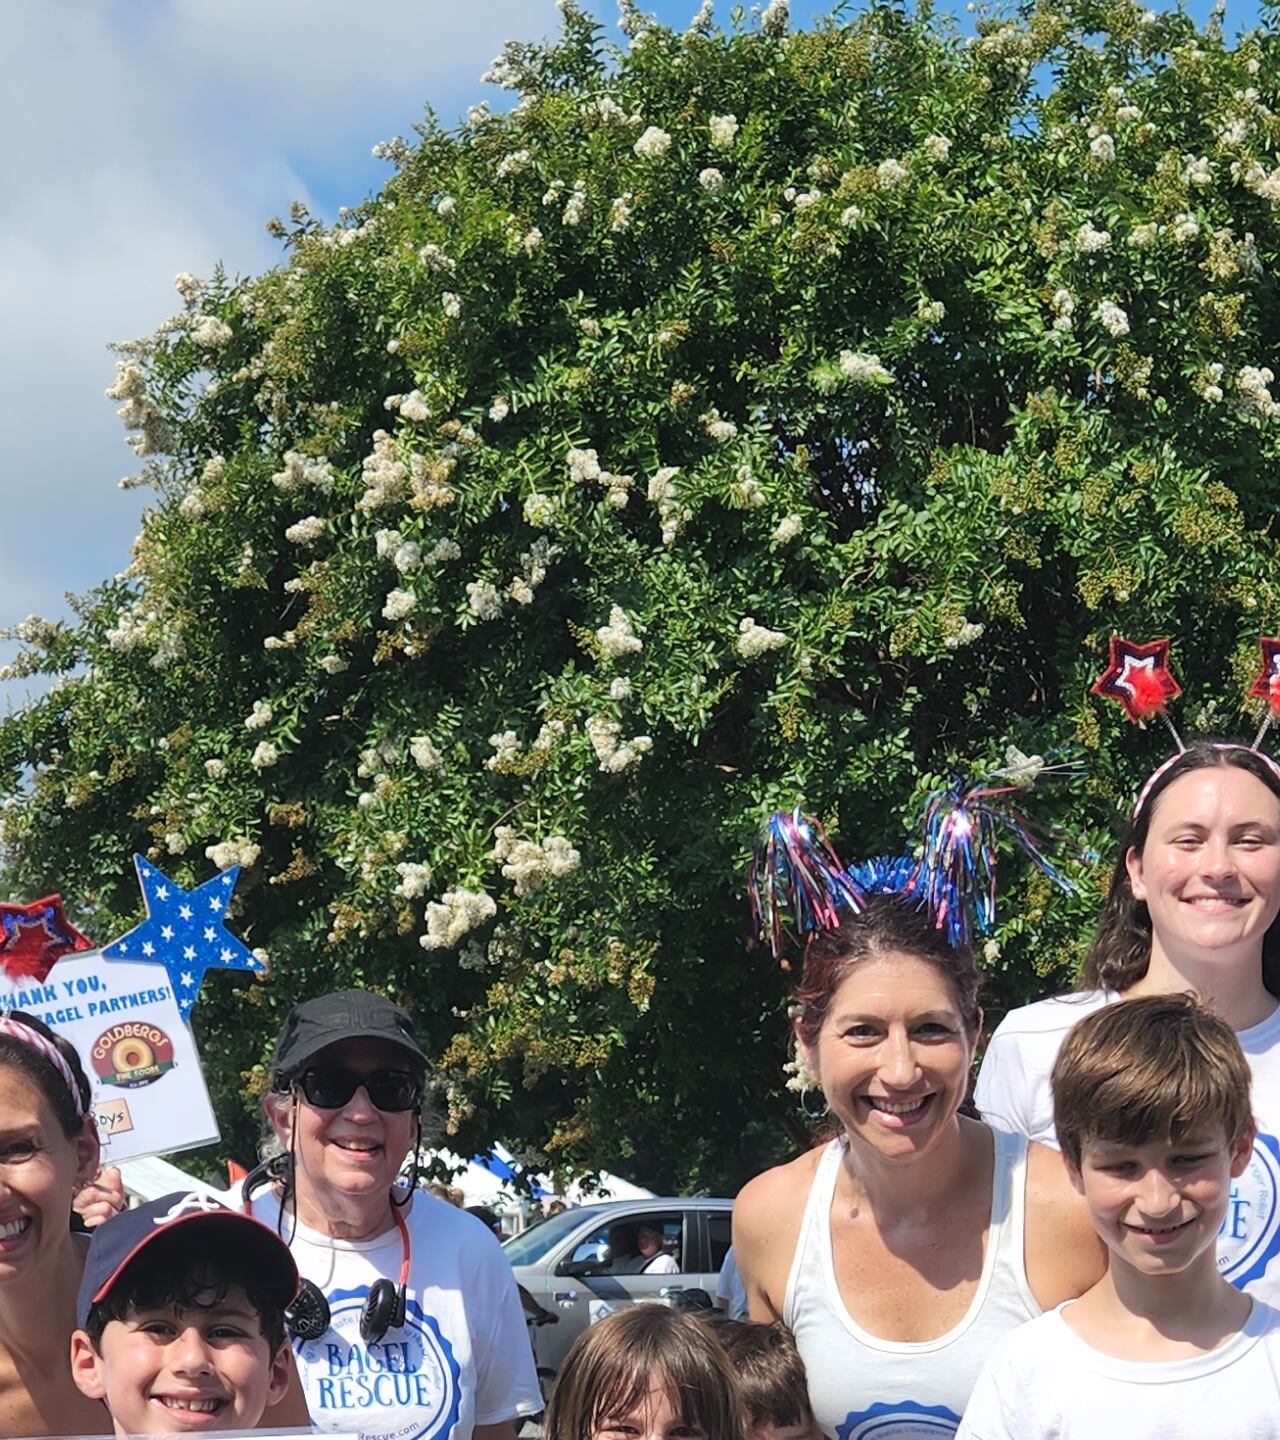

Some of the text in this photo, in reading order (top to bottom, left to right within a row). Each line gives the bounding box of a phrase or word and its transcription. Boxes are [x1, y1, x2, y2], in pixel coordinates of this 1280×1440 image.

[62, 975, 107, 998] YOU,
[88, 986, 171, 1017] PARTNERS!
[93, 1023, 169, 1060] GOLDBERGS
[325, 1342, 416, 1377] BAGEL
[317, 1373, 431, 1409] RESCUE
